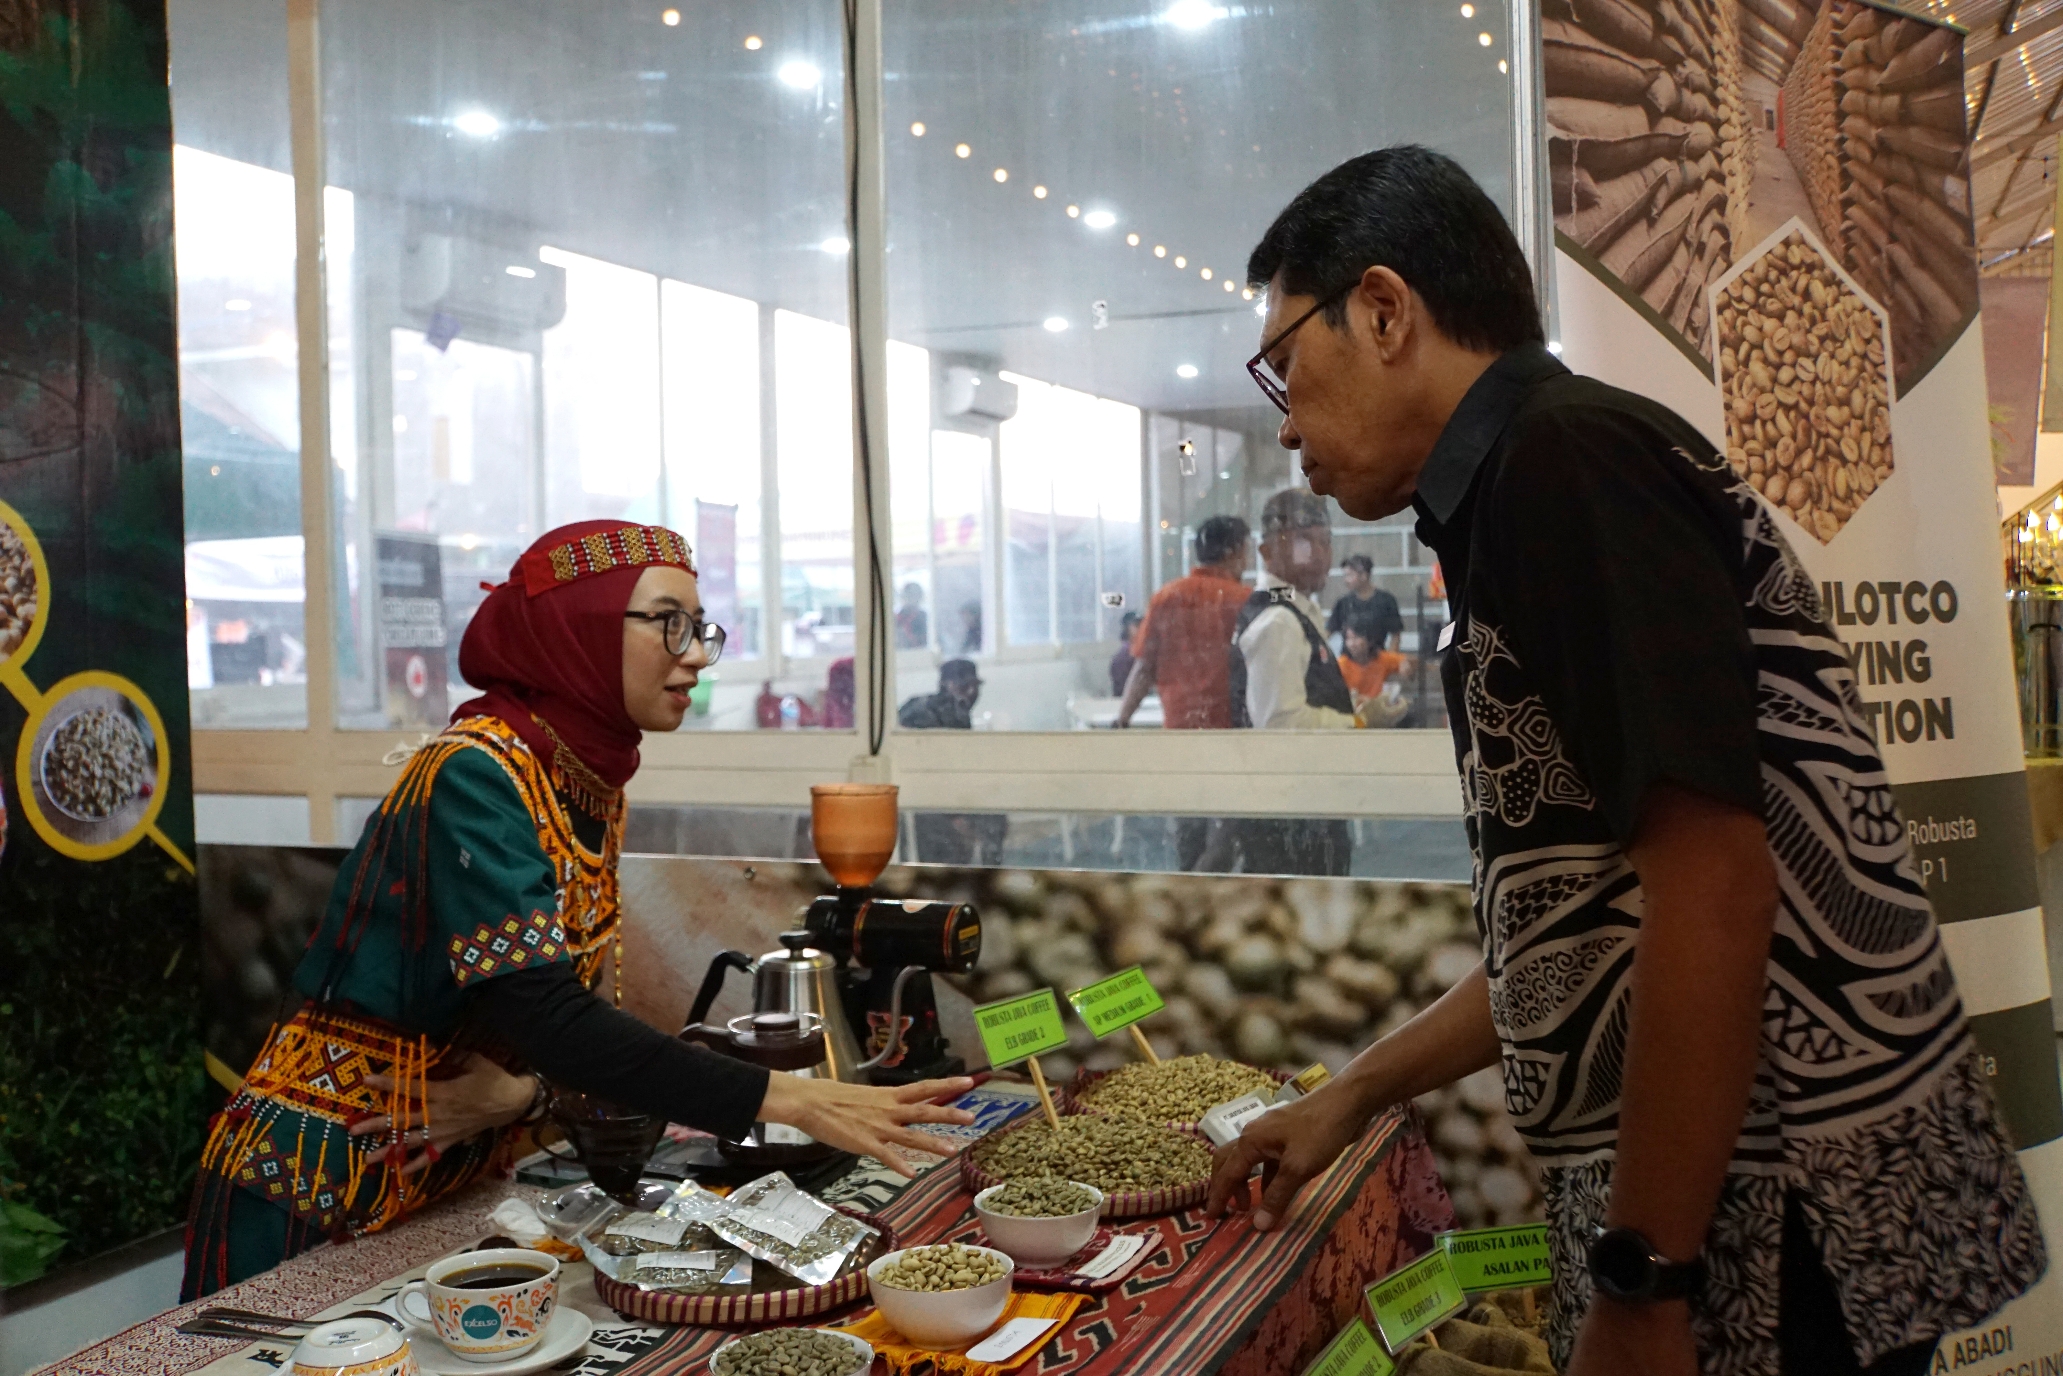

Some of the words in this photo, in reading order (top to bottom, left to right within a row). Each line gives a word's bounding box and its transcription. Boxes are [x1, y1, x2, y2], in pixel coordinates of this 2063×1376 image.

[1906, 815, 1977, 845] Robusta
[1937, 856, 1948, 883] 1
[982, 1010, 1012, 1029] ROBUSTA
[1011, 1005, 1028, 1021] JAVA
[1026, 998, 1051, 1016] COFFEE
[1017, 1028, 1040, 1046] GRADE
[1448, 1236, 1506, 1256] ROBUSTA
[1508, 1232, 1540, 1249] JAVA
[1483, 1258, 1530, 1277] ASALAN
[1375, 1280, 1408, 1309] ROBUSTA
[1404, 1271, 1423, 1291] JAVA
[1420, 1258, 1445, 1282] COFFEE
[463, 1318, 498, 1328] EXCELSO
[1400, 1308, 1415, 1327] ELB
[1413, 1294, 1436, 1318] GRADE
[1332, 1347, 1351, 1373] JAVA
[1344, 1327, 1368, 1357] COFFEE
[1952, 1324, 2014, 1370] ABADI
